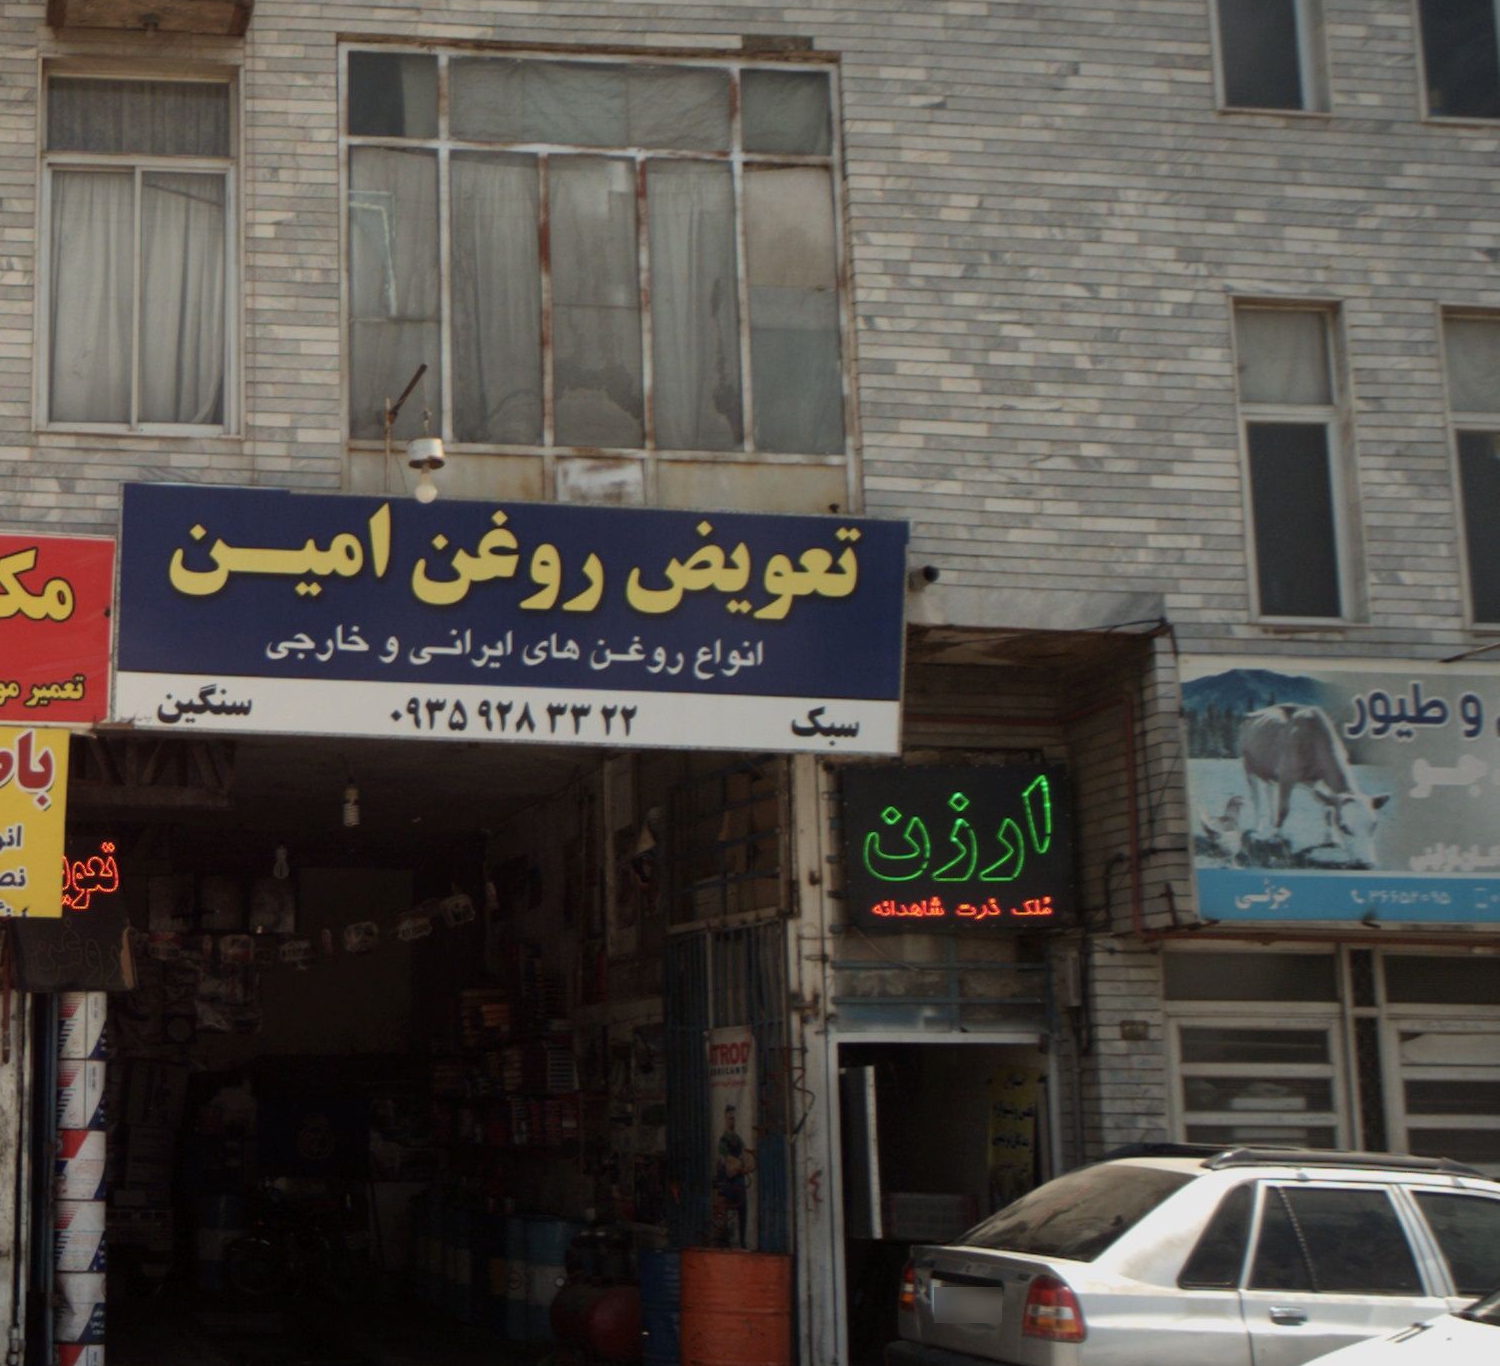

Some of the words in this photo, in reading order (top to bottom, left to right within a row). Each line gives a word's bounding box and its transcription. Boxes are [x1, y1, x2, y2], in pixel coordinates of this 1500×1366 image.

[168, 502, 393, 598] امین
[410, 510, 605, 613] روغن
[625, 519, 863, 620] تعویض
[264, 624, 371, 662] خارجی
[379, 635, 400, 662] و
[409, 628, 514, 667] ایرانی
[523, 633, 581, 664] های
[589, 631, 684, 676] روغن
[693, 637, 765, 679] انواع
[24, 674, 86, 707] تعمیر
[157, 684, 252, 723] سنگین
[1345, 682, 1449, 739] طیور
[389, 698, 469, 732] ۰۹۳۵
[477, 698, 535, 733] ۹۲۸
[545, 702, 591, 735] ۳۳
[600, 703, 638, 736] ۲۲
[791, 705, 861, 746] سبک
[1459, 692, 1485, 738] و
[863, 774, 1052, 881] ارزن
[872, 896, 945, 917] شاهدانه
[955, 897, 1000, 920] ذرت
